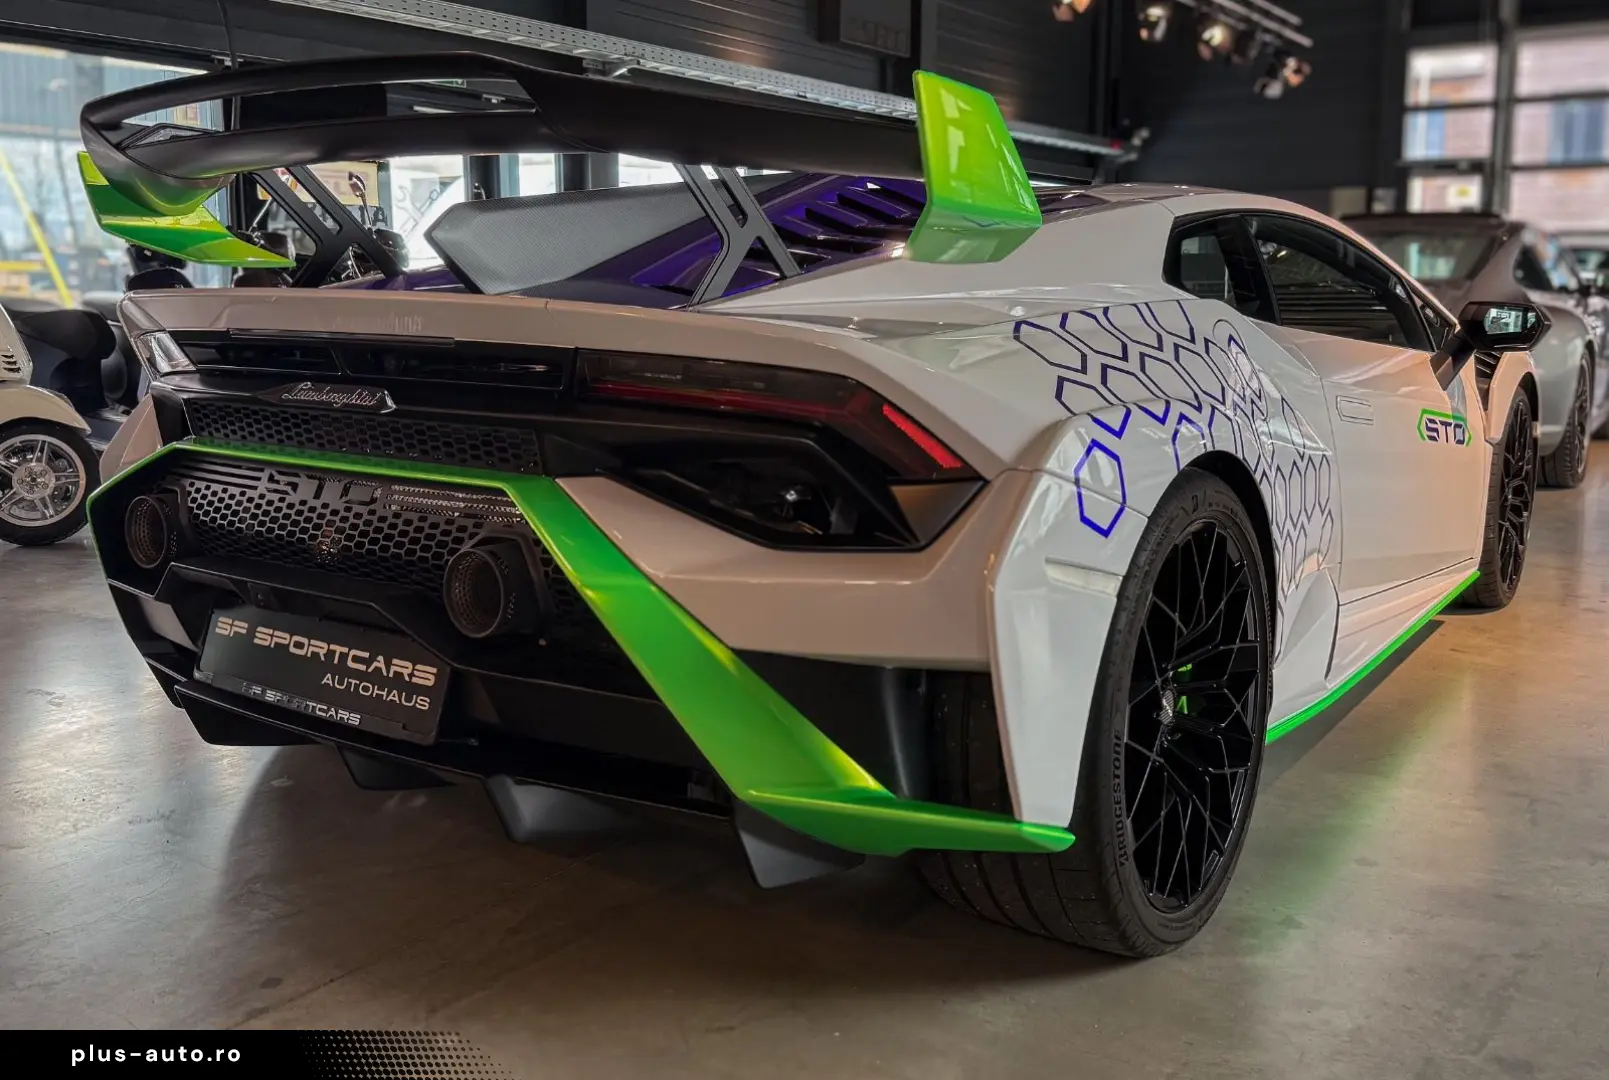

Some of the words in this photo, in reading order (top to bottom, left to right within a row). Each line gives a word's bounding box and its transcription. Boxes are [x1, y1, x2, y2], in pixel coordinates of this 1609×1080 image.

[281, 381, 382, 407] Lamborghini
[1424, 417, 1466, 445] STO
[266, 470, 383, 506] STO
[214, 616, 248, 637] SF
[253, 626, 438, 687] SPORTCARS
[321, 673, 431, 710] AUTOHAUS
[1112, 729, 1129, 868] BRIDGESTONE
